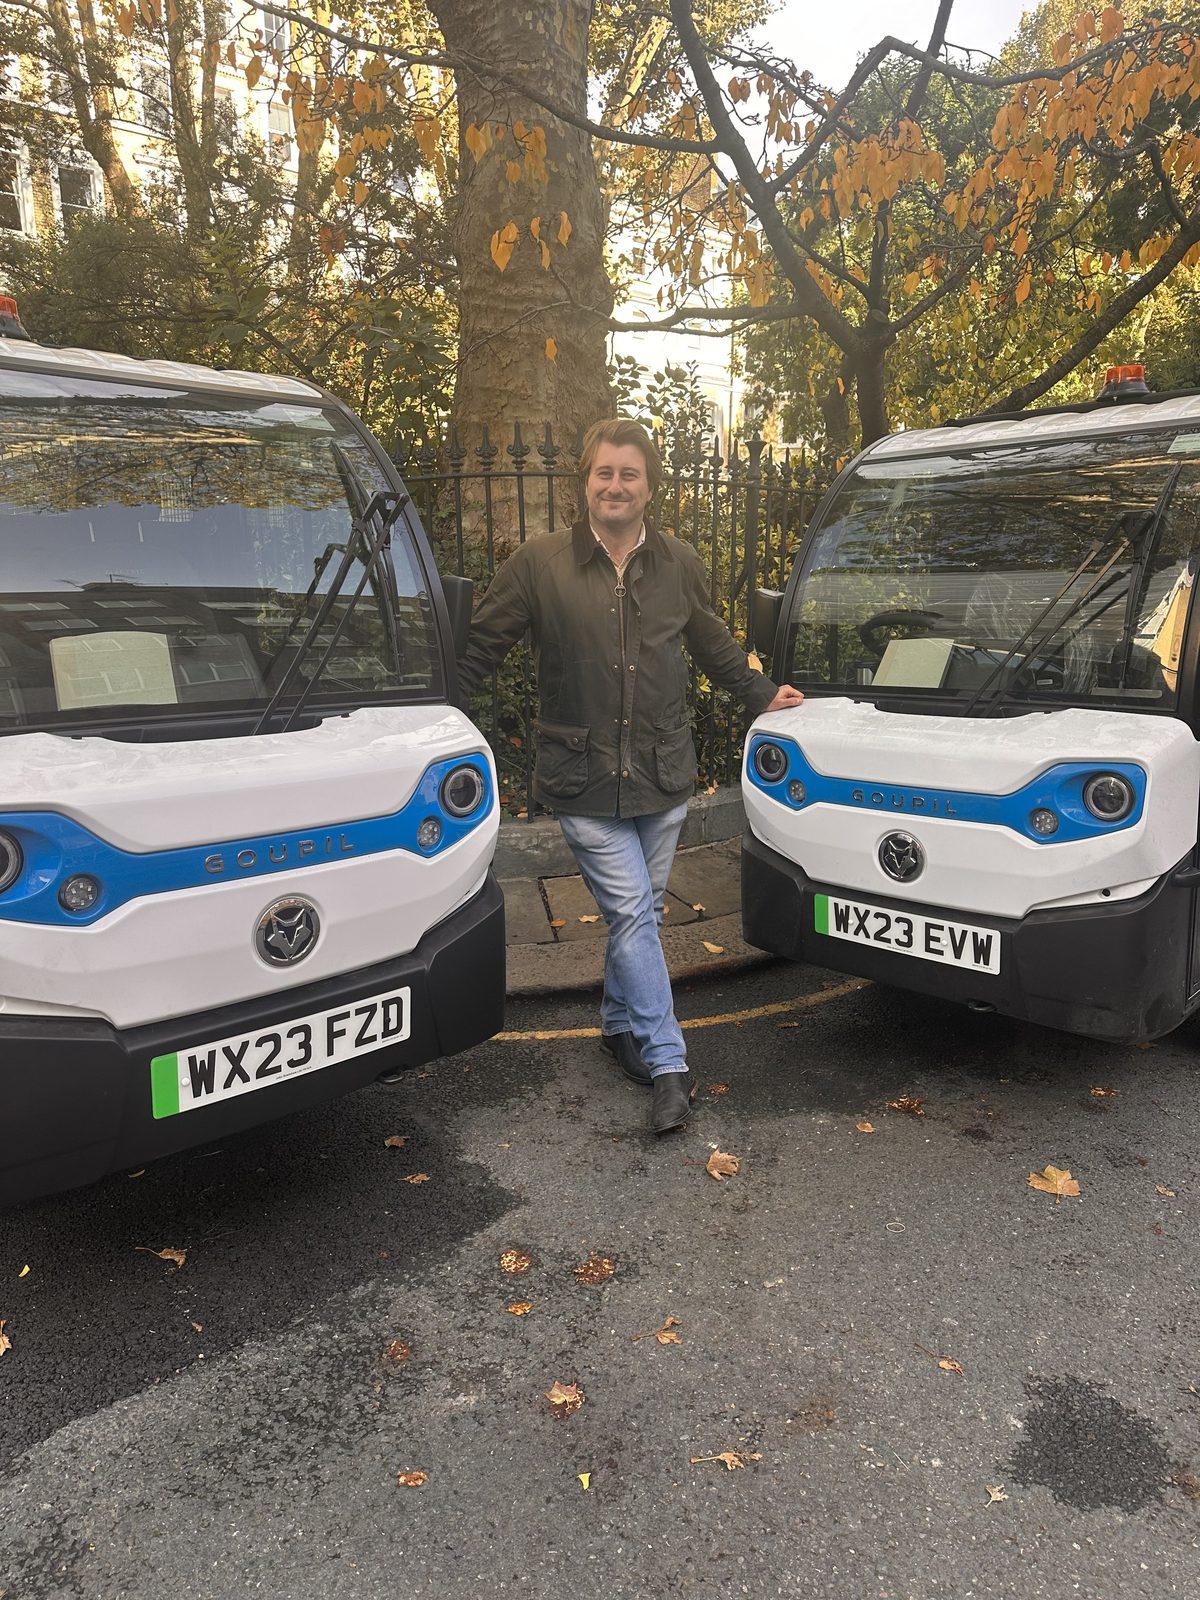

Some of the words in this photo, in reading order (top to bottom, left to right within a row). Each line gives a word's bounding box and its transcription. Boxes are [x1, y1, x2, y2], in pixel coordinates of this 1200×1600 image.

[852, 789, 957, 814] GOUPIL
[204, 833, 354, 874] GOUPIL
[834, 902, 913, 949] WX23
[925, 921, 993, 967] EVW
[187, 1023, 312, 1099] WX23
[327, 996, 403, 1058] FZD
